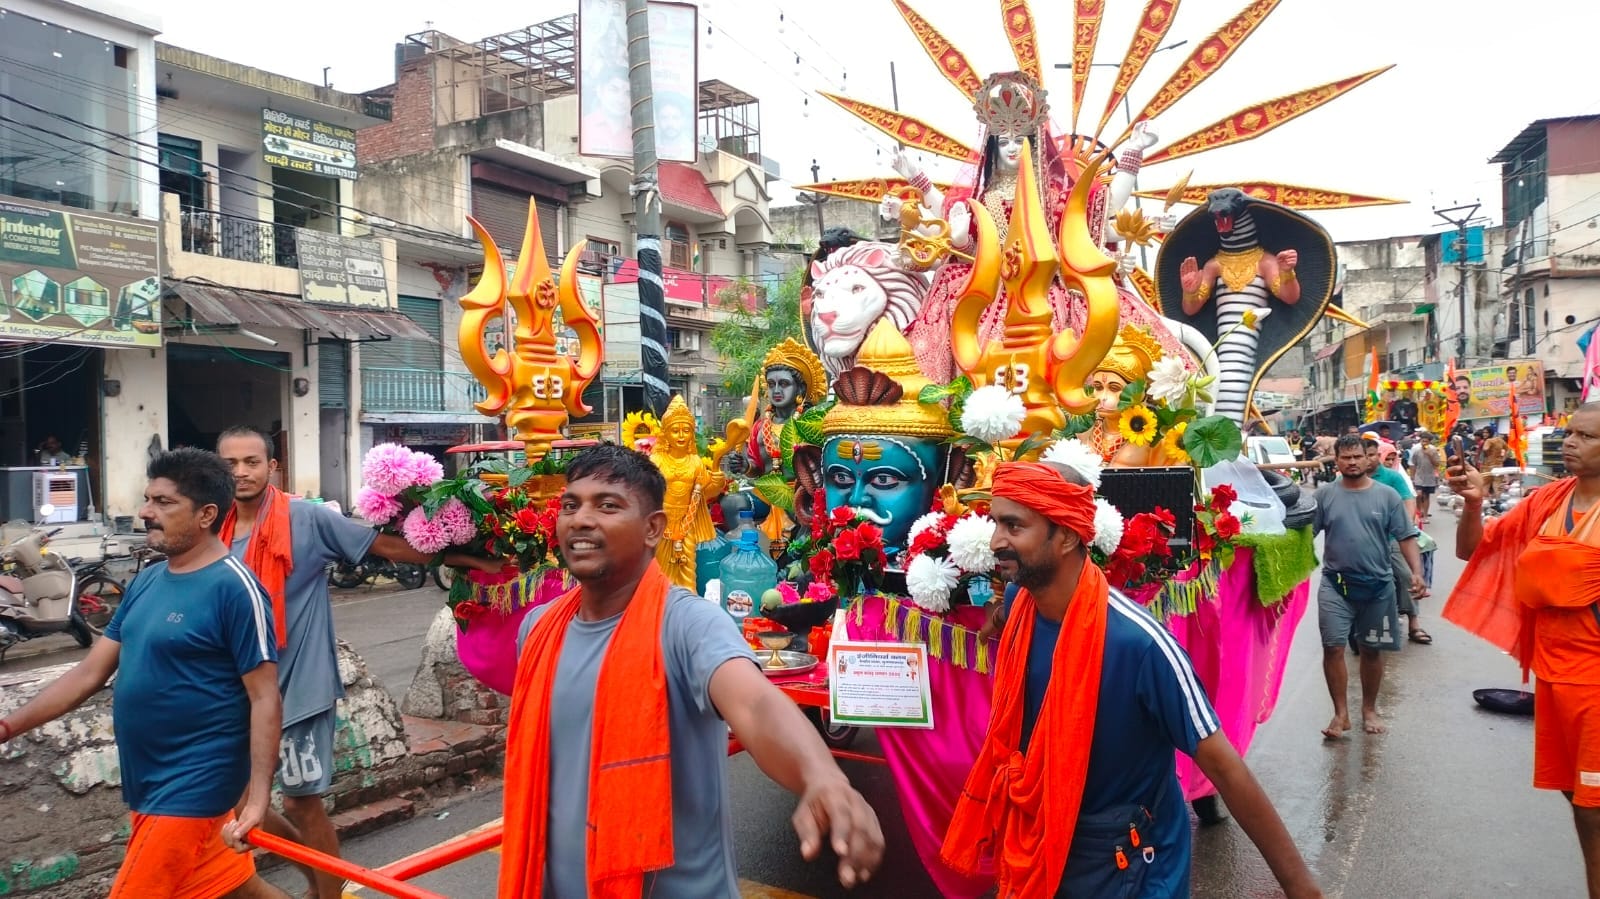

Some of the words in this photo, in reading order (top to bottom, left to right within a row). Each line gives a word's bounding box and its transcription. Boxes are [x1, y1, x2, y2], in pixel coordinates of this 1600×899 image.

[264, 154, 288, 167] शादी
[290, 160, 312, 171] कार्ड
[10, 326, 31, 335] Main
